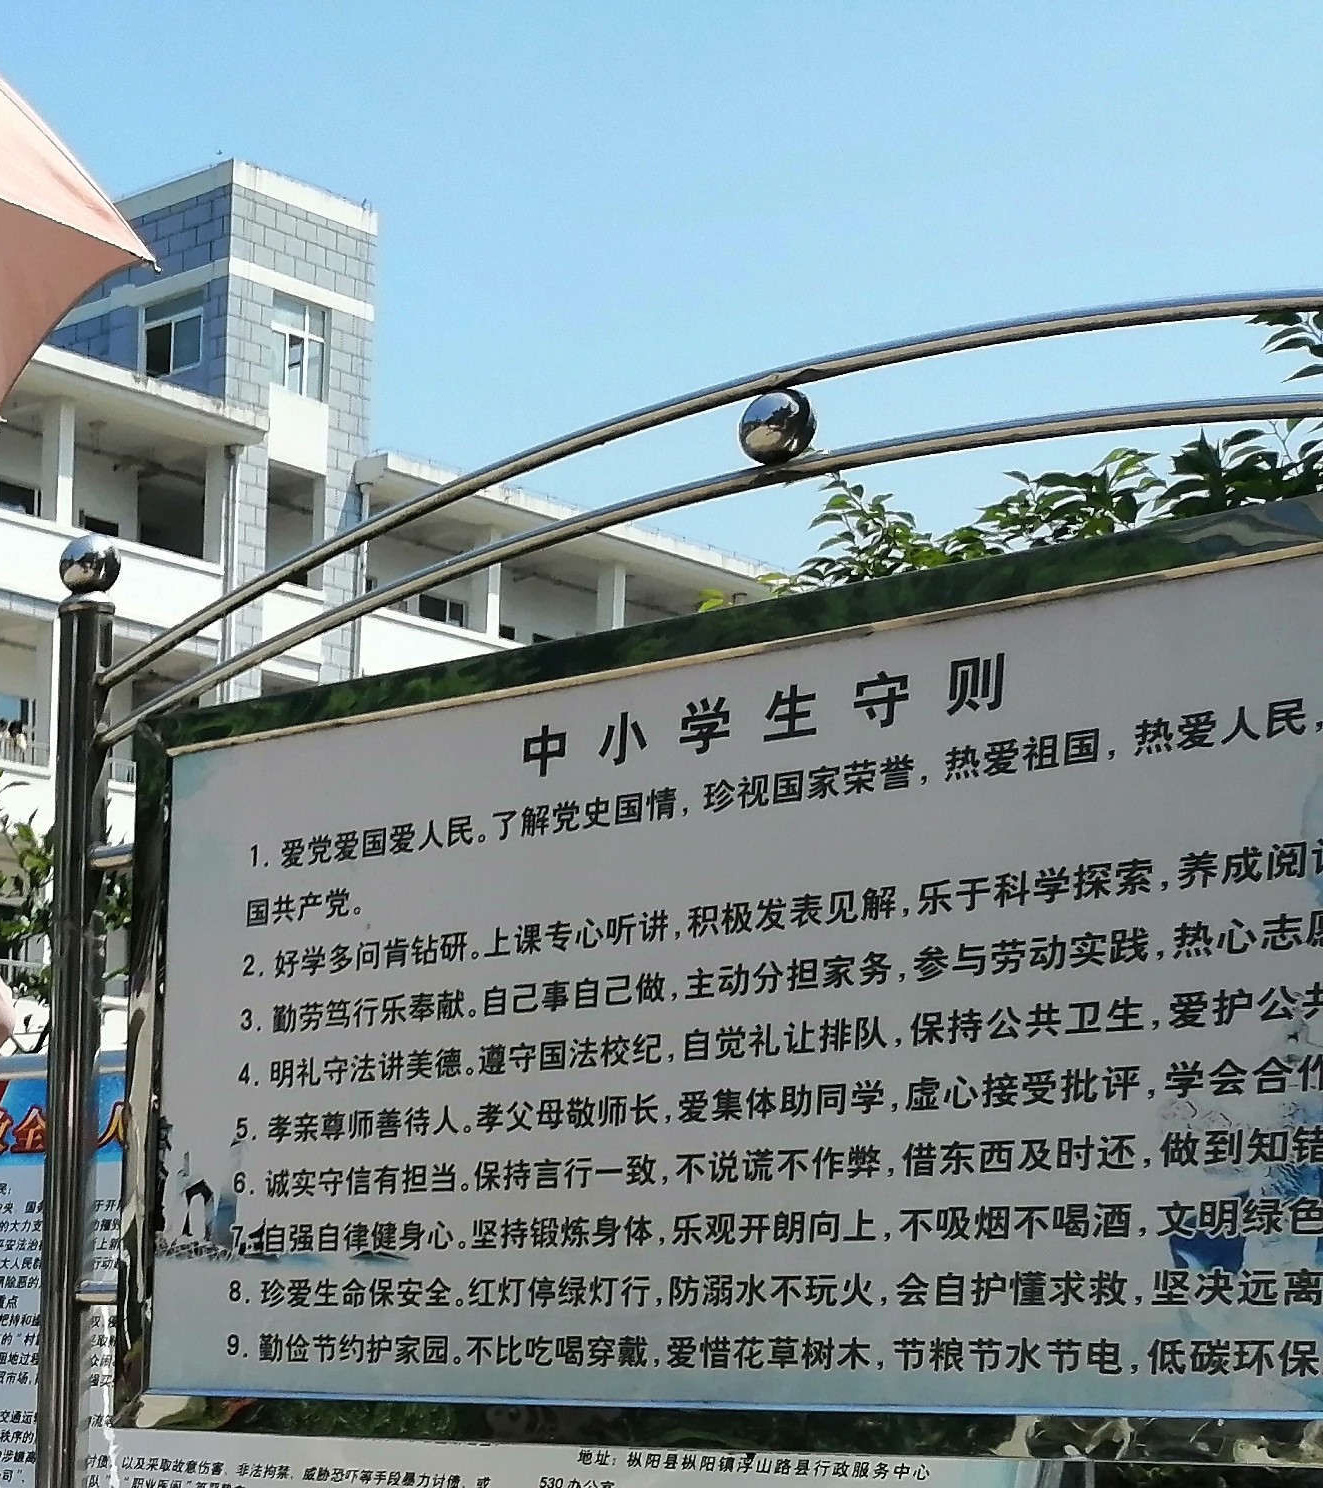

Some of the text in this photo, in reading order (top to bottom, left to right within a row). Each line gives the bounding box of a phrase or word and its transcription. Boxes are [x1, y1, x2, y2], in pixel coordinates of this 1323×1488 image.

[523, 652, 1006, 778] 中小学生守则
[245, 887, 363, 929] 国共产党。
